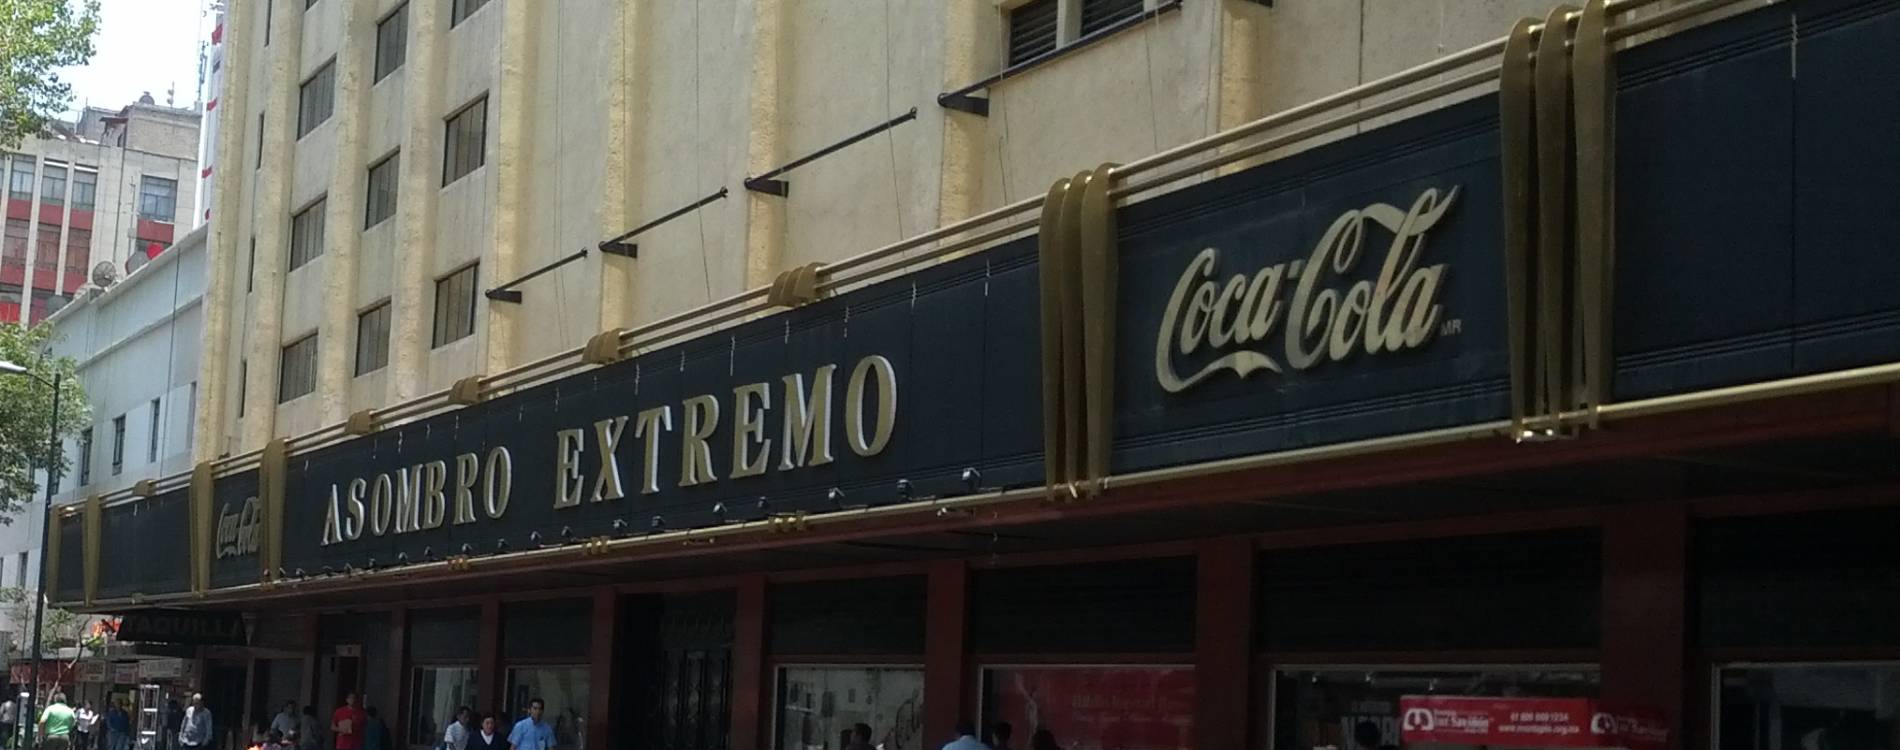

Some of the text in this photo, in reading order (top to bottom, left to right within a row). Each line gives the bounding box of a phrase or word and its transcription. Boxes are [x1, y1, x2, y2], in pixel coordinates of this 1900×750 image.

[1155, 184, 1460, 393] Coca-Cola
[1440, 318, 1463, 337] MR
[321, 354, 897, 546] ASOMBRO EXTREMO
